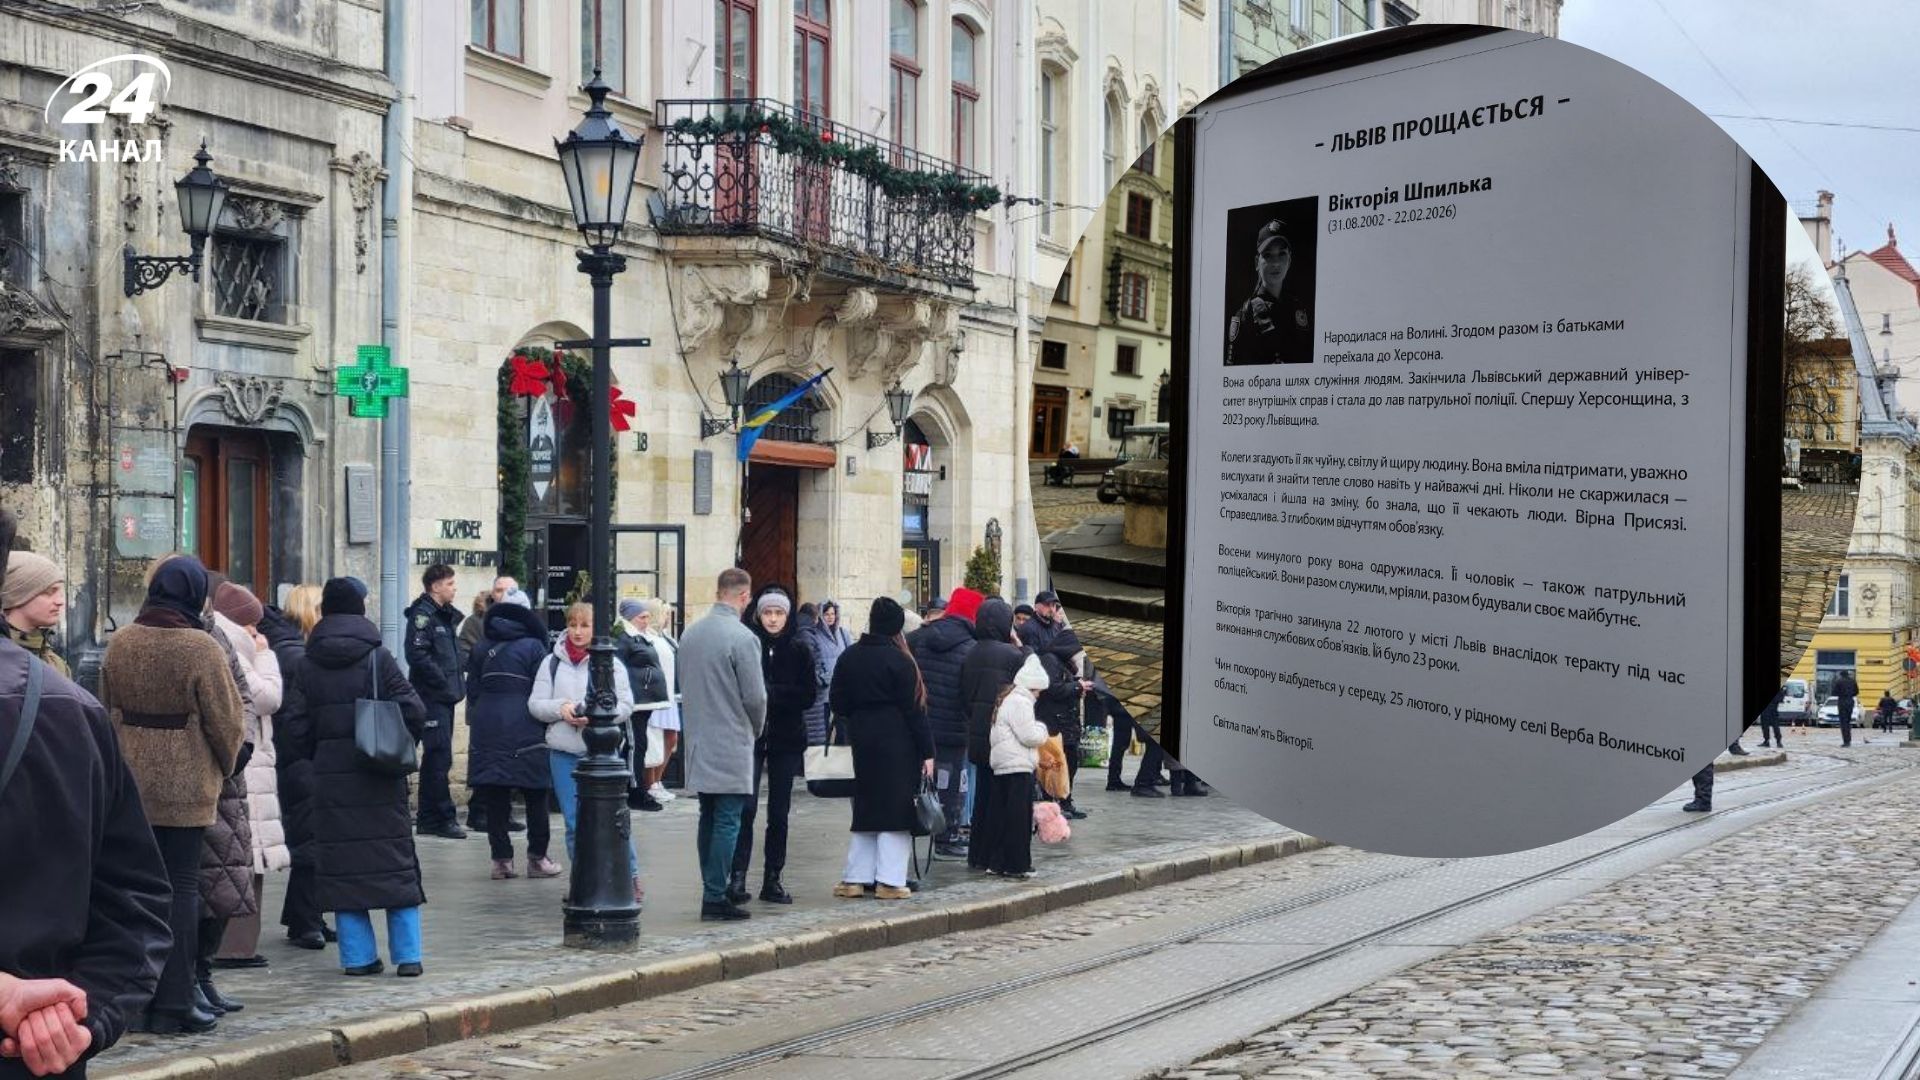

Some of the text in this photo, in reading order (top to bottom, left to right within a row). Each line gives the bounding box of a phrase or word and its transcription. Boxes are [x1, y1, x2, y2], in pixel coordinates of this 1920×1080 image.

[1330, 125, 1386, 153] ЛЬВІВ
[1392, 94, 1544, 142] ПРОЩАЄТЬСЯ
[1328, 176, 1492, 212] Вікторія Шпилька
[1328, 213, 1385, 235] (31.08.2002
[1394, 203, 1457, 224] 22.02.2026)
[1324, 318, 1624, 346] Народилася на Волині. Згодом разом із батьками
[1323, 348, 1444, 366] переїхала до Херсона.
[1222, 367, 1690, 390] Вона обрала шлях служіння людям. Закінчила Львівський державний універ-
[1222, 391, 1690, 409] ситет внутрішніх справ і стала до лав патрульної поліції. Спершу Херсонщина, з
[1222, 413, 1320, 429] 2023 року Львівщина.
[637, 432, 648, 452] 18
[1221, 450, 1252, 463] Колеги
[1252, 454, 1294, 467] згадують
[1295, 453, 1302, 465] її
[1302, 456, 1314, 465] як
[1347, 455, 1379, 471] світлу
[1380, 456, 1388, 468] й
[1389, 458, 1421, 473] щиру
[1422, 460, 1470, 475] людину.
[1472, 458, 1503, 473] Вона
[1505, 460, 1541, 474] вміла
[1544, 461, 1627, 480] підтримати,
[1630, 467, 1688, 482] уважно
[1221, 472, 1265, 485] вислухати
[1267, 472, 1274, 483] й
[1276, 473, 1309, 485] знайти
[1312, 476, 1340, 487] тепле
[1343, 478, 1374, 488] слово
[1377, 478, 1411, 490] навіть
[1414, 481, 1422, 494] у
[1424, 479, 1479, 494] найважчі
[1482, 482, 1505, 496] дні.
[1508, 482, 1553, 498] Ніколи
[1558, 488, 1575, 500] не
[1579, 489, 1669, 505] скаржилася
[1220, 490, 1268, 502] усміхалася
[1273, 492, 1276, 503] і
[1281, 492, 1307, 505] йшла
[1312, 496, 1325, 506] на
[1365, 496, 1380, 510] бо
[1385, 500, 1420, 514] знала,
[1427, 503, 1446, 516] що
[1452, 502, 1460, 515] її
[1466, 506, 1519, 519] чекають
[1527, 510, 1567, 524] люди.
[1576, 508, 1615, 528] Вірна
[1624, 512, 1687, 532] Присязі.
[1280, 510, 1287, 523] З
[1288, 512, 1335, 527] глибоким
[1336, 516, 1387, 533] відчуттям
[1218, 543, 1251, 558] Восени
[1256, 551, 1302, 565] минулого
[1307, 556, 1332, 571] року
[1338, 559, 1364, 571] вона
[1370, 562, 1444, 580] одружилася.
[1451, 565, 1458, 582] Її
[1465, 572, 1515, 588] чоловік
[1542, 581, 1585, 596] також
[1594, 586, 1686, 608] патрульний
[1218, 565, 1280, 582] поліцейський.
[1281, 570, 1305, 585] Вони
[1306, 576, 1338, 589] разом
[1338, 580, 1388, 597] служили,
[1432, 591, 1470, 606] разом
[1472, 592, 1532, 613] будували
[1534, 604, 1566, 618] своє
[1568, 607, 1641, 628] майбутнє.
[1216, 600, 1686, 685] Вікторія трагічно загинула 22 лютого у місті Львів внаслідок теракту під час
[1216, 622, 1262, 638] виконання
[1263, 630, 1316, 648] службових
[1372, 642, 1382, 659] Їй
[1383, 646, 1410, 664] було
[1412, 651, 1426, 666] 23
[1428, 657, 1460, 672] роки.
[1214, 677, 1248, 695] області.
[1214, 656, 1232, 671] Чин
[1233, 664, 1277, 684] похорону
[1278, 671, 1336, 692] відбудеться
[1338, 684, 1345, 698] у
[1390, 690, 1404, 706] 25
[1454, 706, 1462, 721] у
[1465, 707, 1517, 732] рідному
[1520, 720, 1547, 735] селі
[1550, 722, 1594, 745] Верба
[1598, 731, 1685, 763] Волинської
[1213, 714, 1240, 732] Світла
[1276, 729, 1314, 751] Вікторії.
